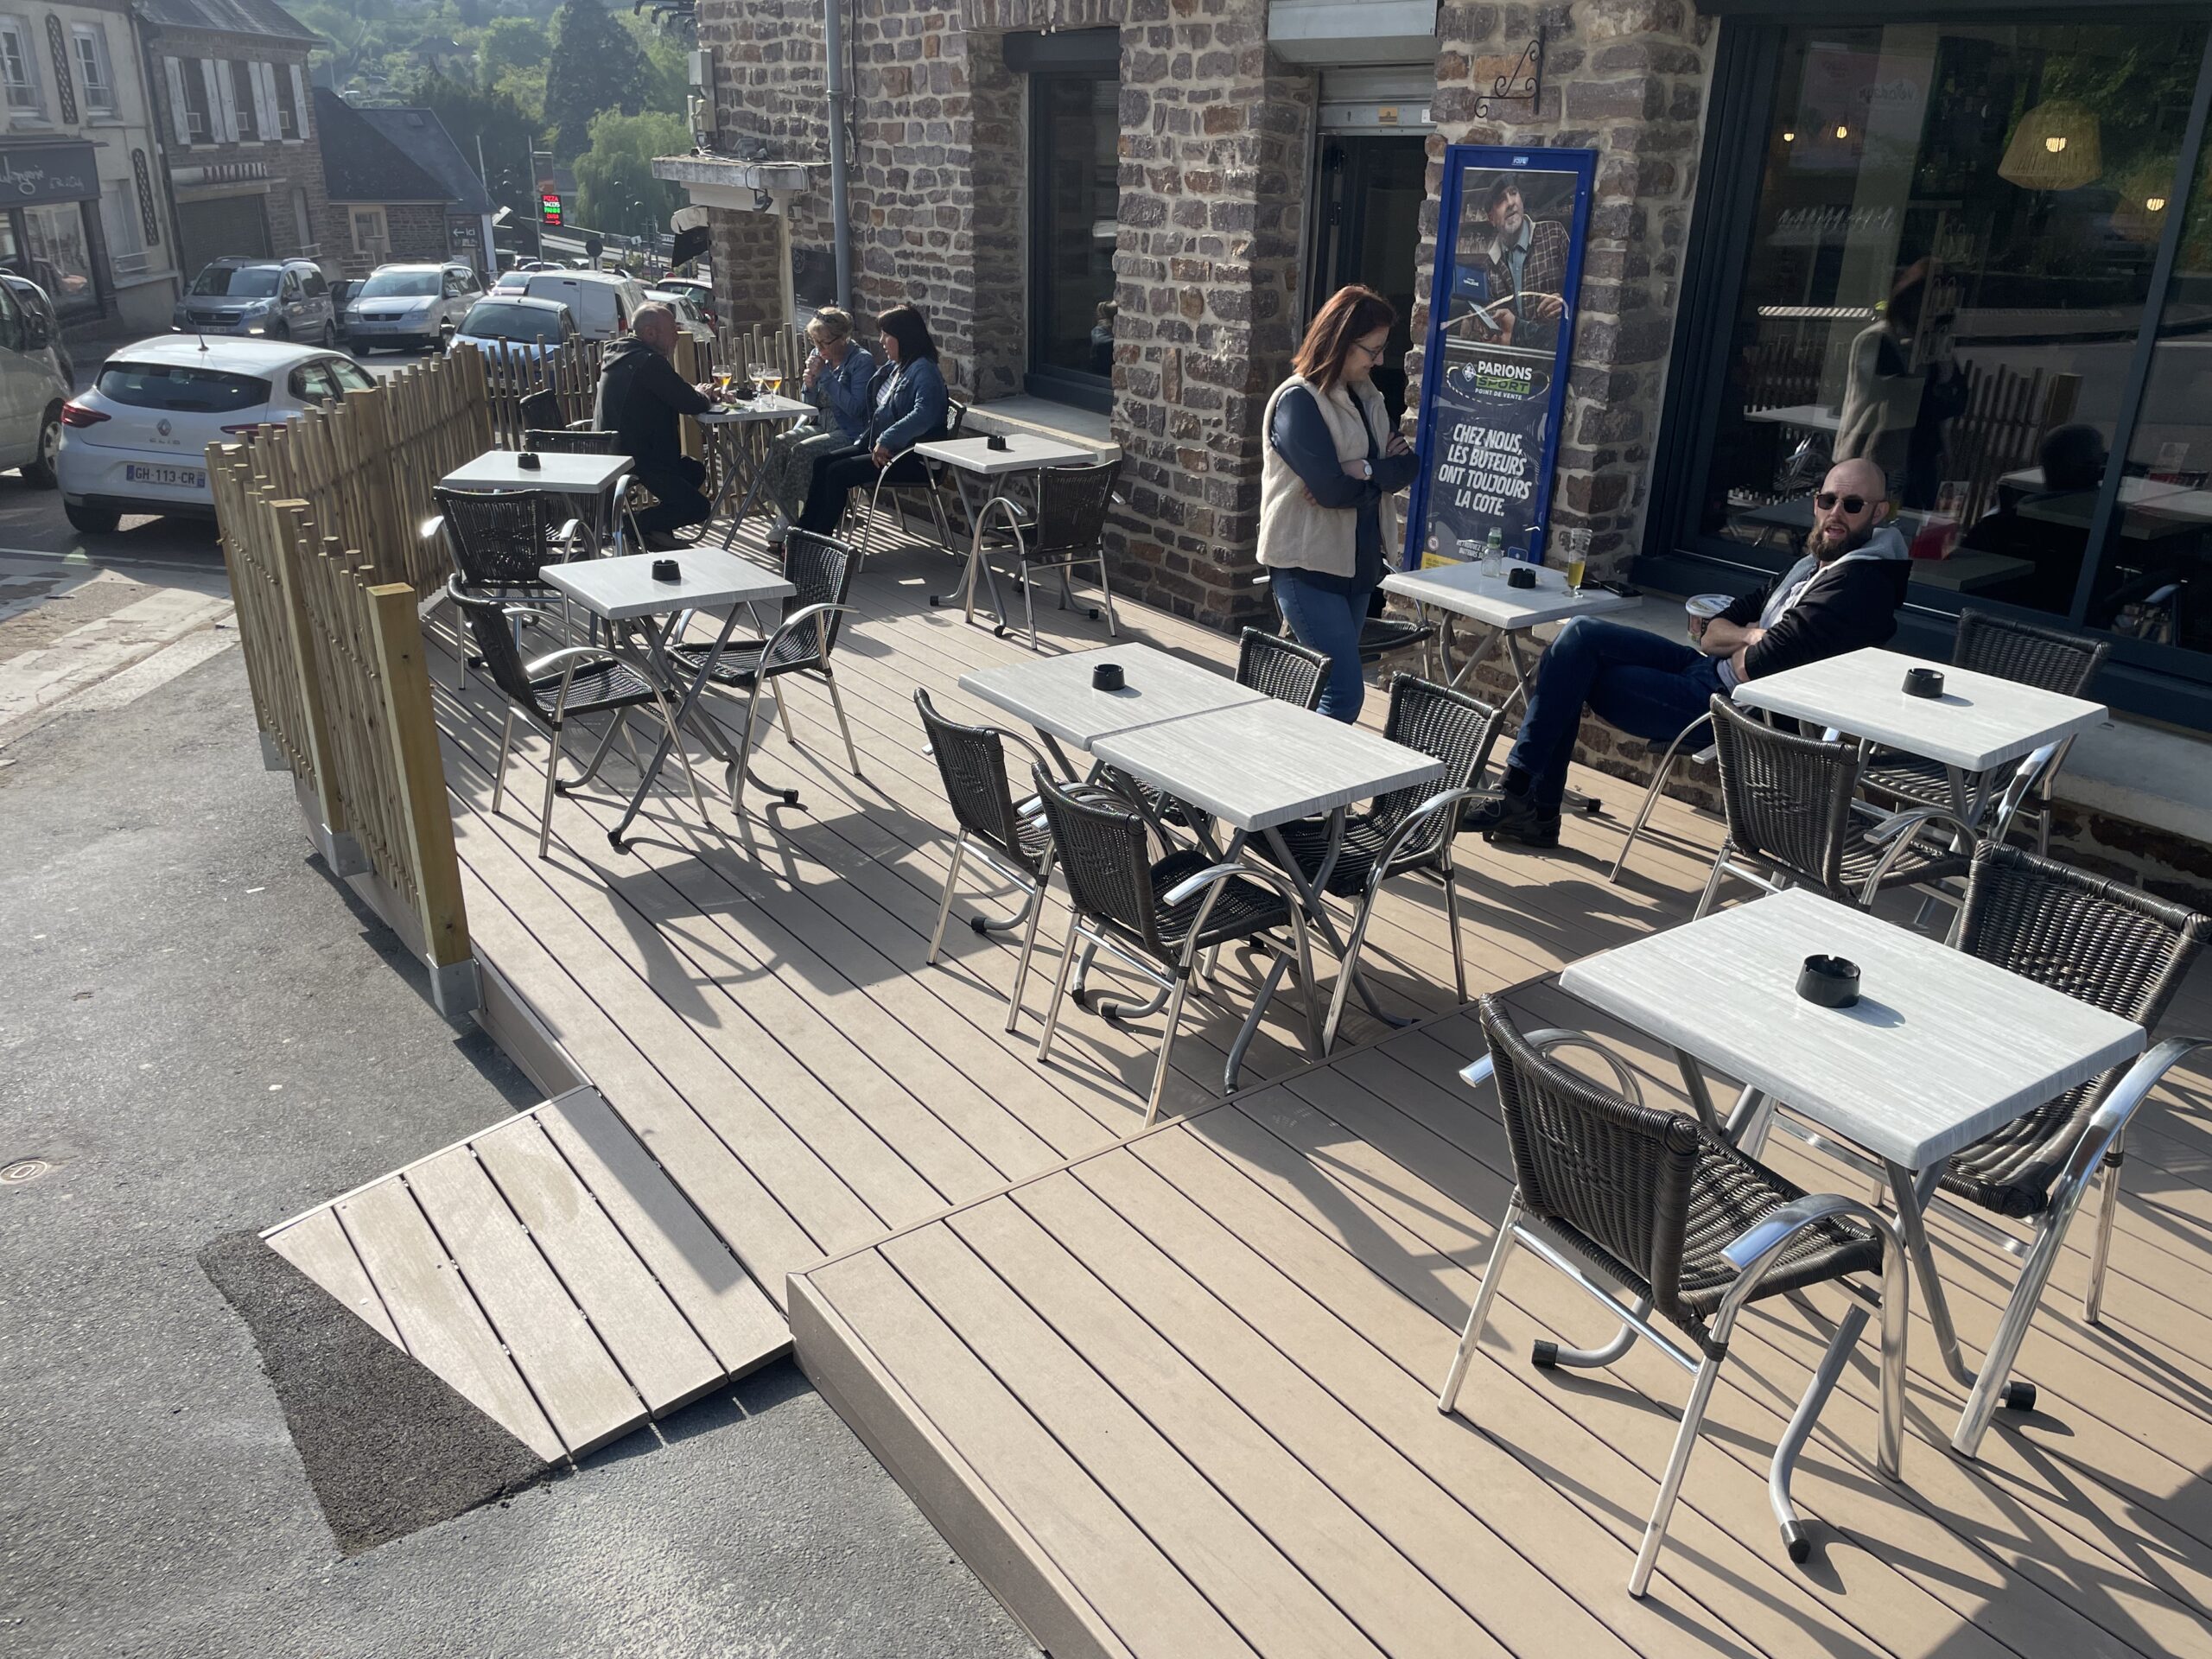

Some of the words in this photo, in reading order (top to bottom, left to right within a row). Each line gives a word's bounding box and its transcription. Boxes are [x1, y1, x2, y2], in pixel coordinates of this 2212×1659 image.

[1478, 360, 1533, 381] PARIONS
[1474, 387, 1492, 396] POINT
[1478, 377, 1529, 392] SPORT
[1453, 423, 1485, 446] CHEZ
[1484, 429, 1522, 455] NOUS,
[1447, 444, 1470, 464] LES
[1469, 448, 1527, 476] BUTEURS
[136, 467, 195, 484] GH-113-CR
[1438, 464, 1466, 485] ONT
[1466, 469, 1533, 499] TOUJOURS
[1455, 489, 1471, 508] LA
[1472, 493, 1505, 517] COTE.
